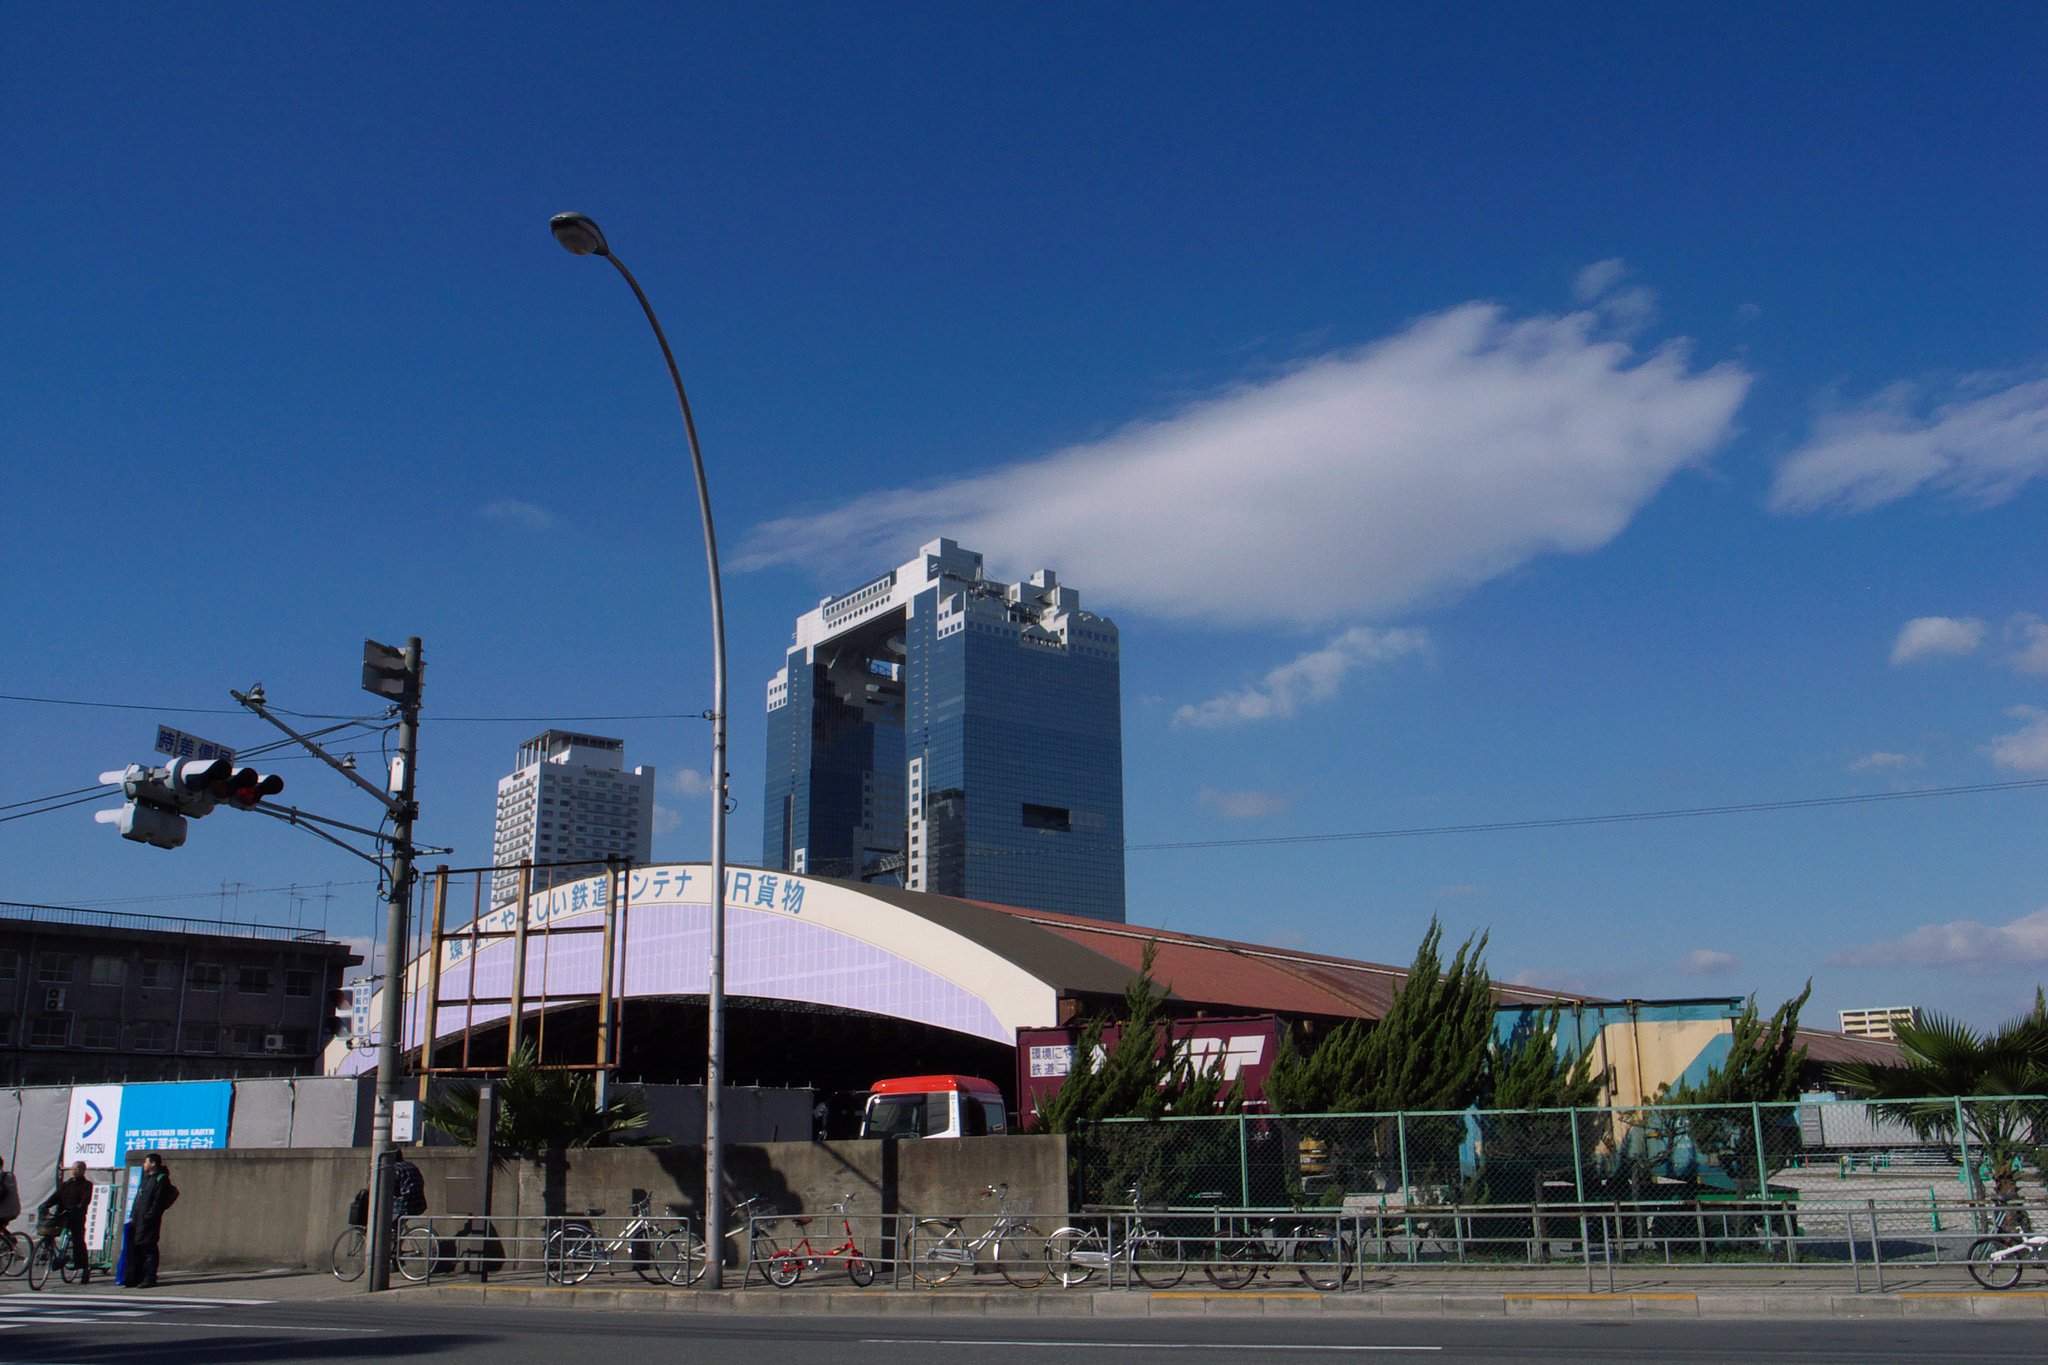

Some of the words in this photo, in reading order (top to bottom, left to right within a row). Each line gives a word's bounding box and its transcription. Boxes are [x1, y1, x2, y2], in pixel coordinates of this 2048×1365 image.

[449, 868, 693, 961] 環にやしい鉄道コンテナ
